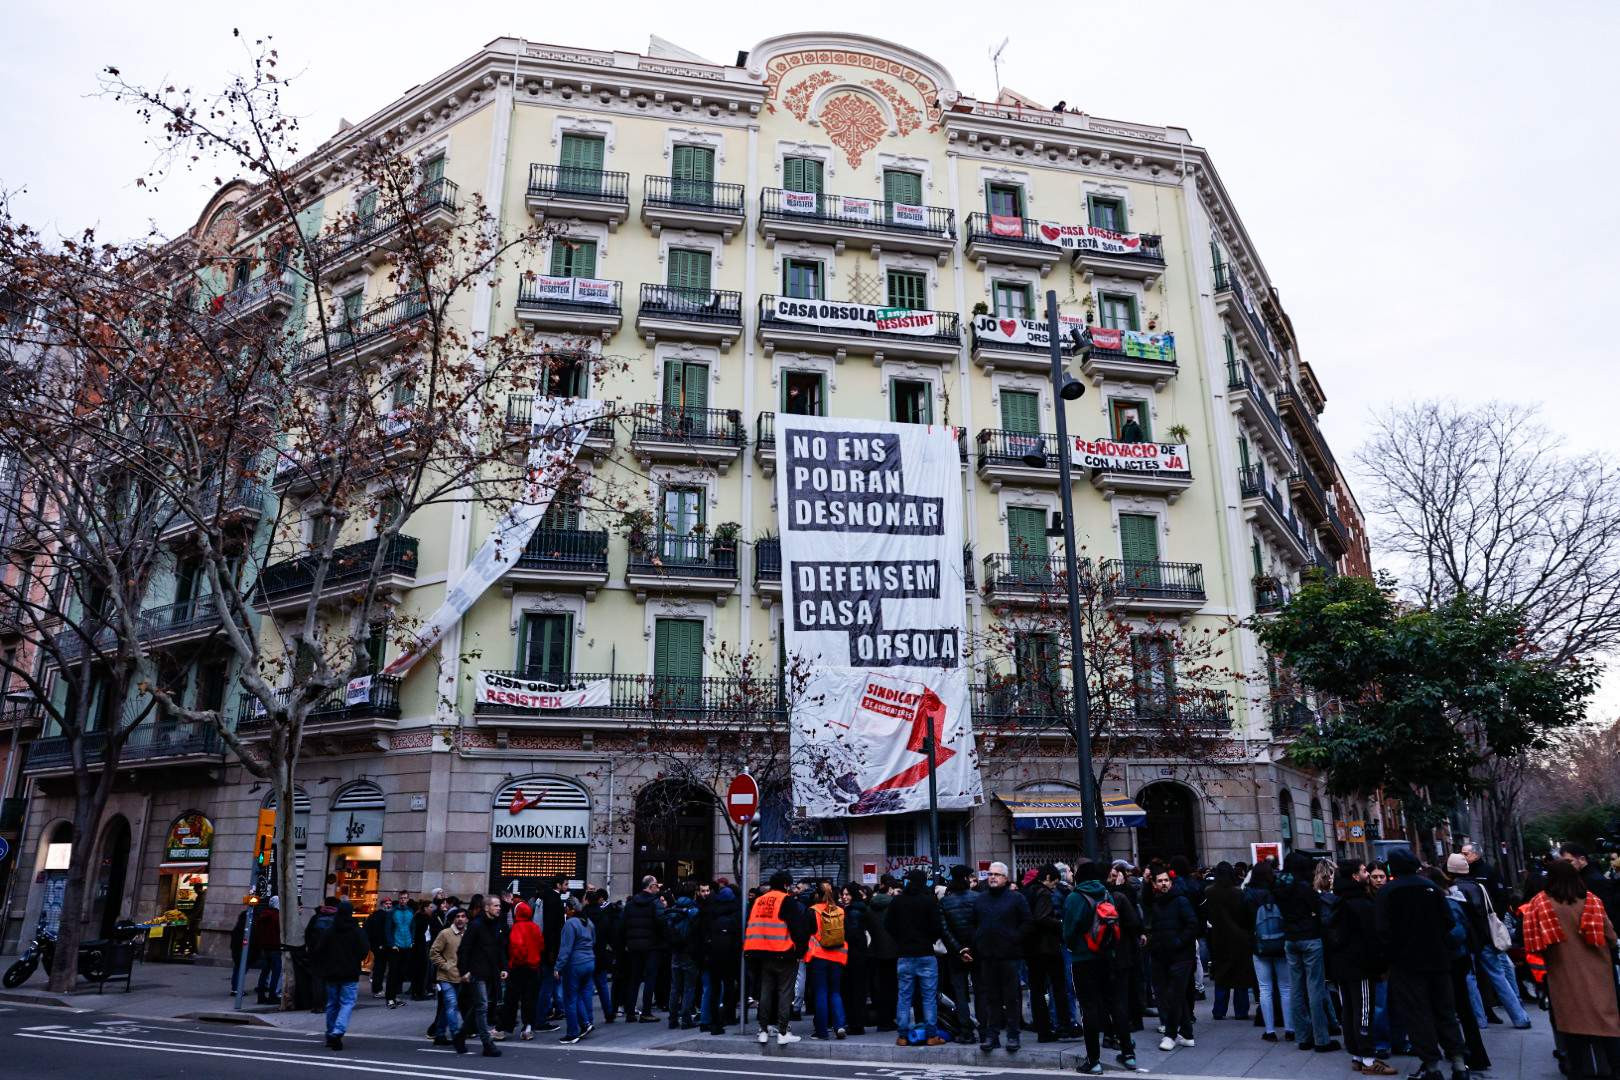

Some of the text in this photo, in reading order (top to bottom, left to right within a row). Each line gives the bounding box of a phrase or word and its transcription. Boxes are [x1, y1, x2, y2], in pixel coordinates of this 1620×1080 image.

[1061, 226, 1084, 236] CASA
[1061, 237, 1073, 247] NO
[779, 301, 877, 323] CASA ORSOLA
[876, 314, 934, 330] RESISTINT
[977, 319, 997, 331] JO
[793, 435, 886, 462] NO ENS
[1160, 445, 1176, 455] DE
[794, 467, 900, 494] PODRAN
[795, 499, 938, 527] DESNONAR
[798, 565, 935, 592] DEFENSEM
[799, 599, 874, 626] CASA
[857, 633, 956, 661] ORSOLA
[484, 674, 587, 693] CASA ORSOLA
[486, 688, 562, 708] RESISTEIX
[867, 683, 920, 706] SINDICAT
[495, 824, 586, 839] BOMBONERIA
